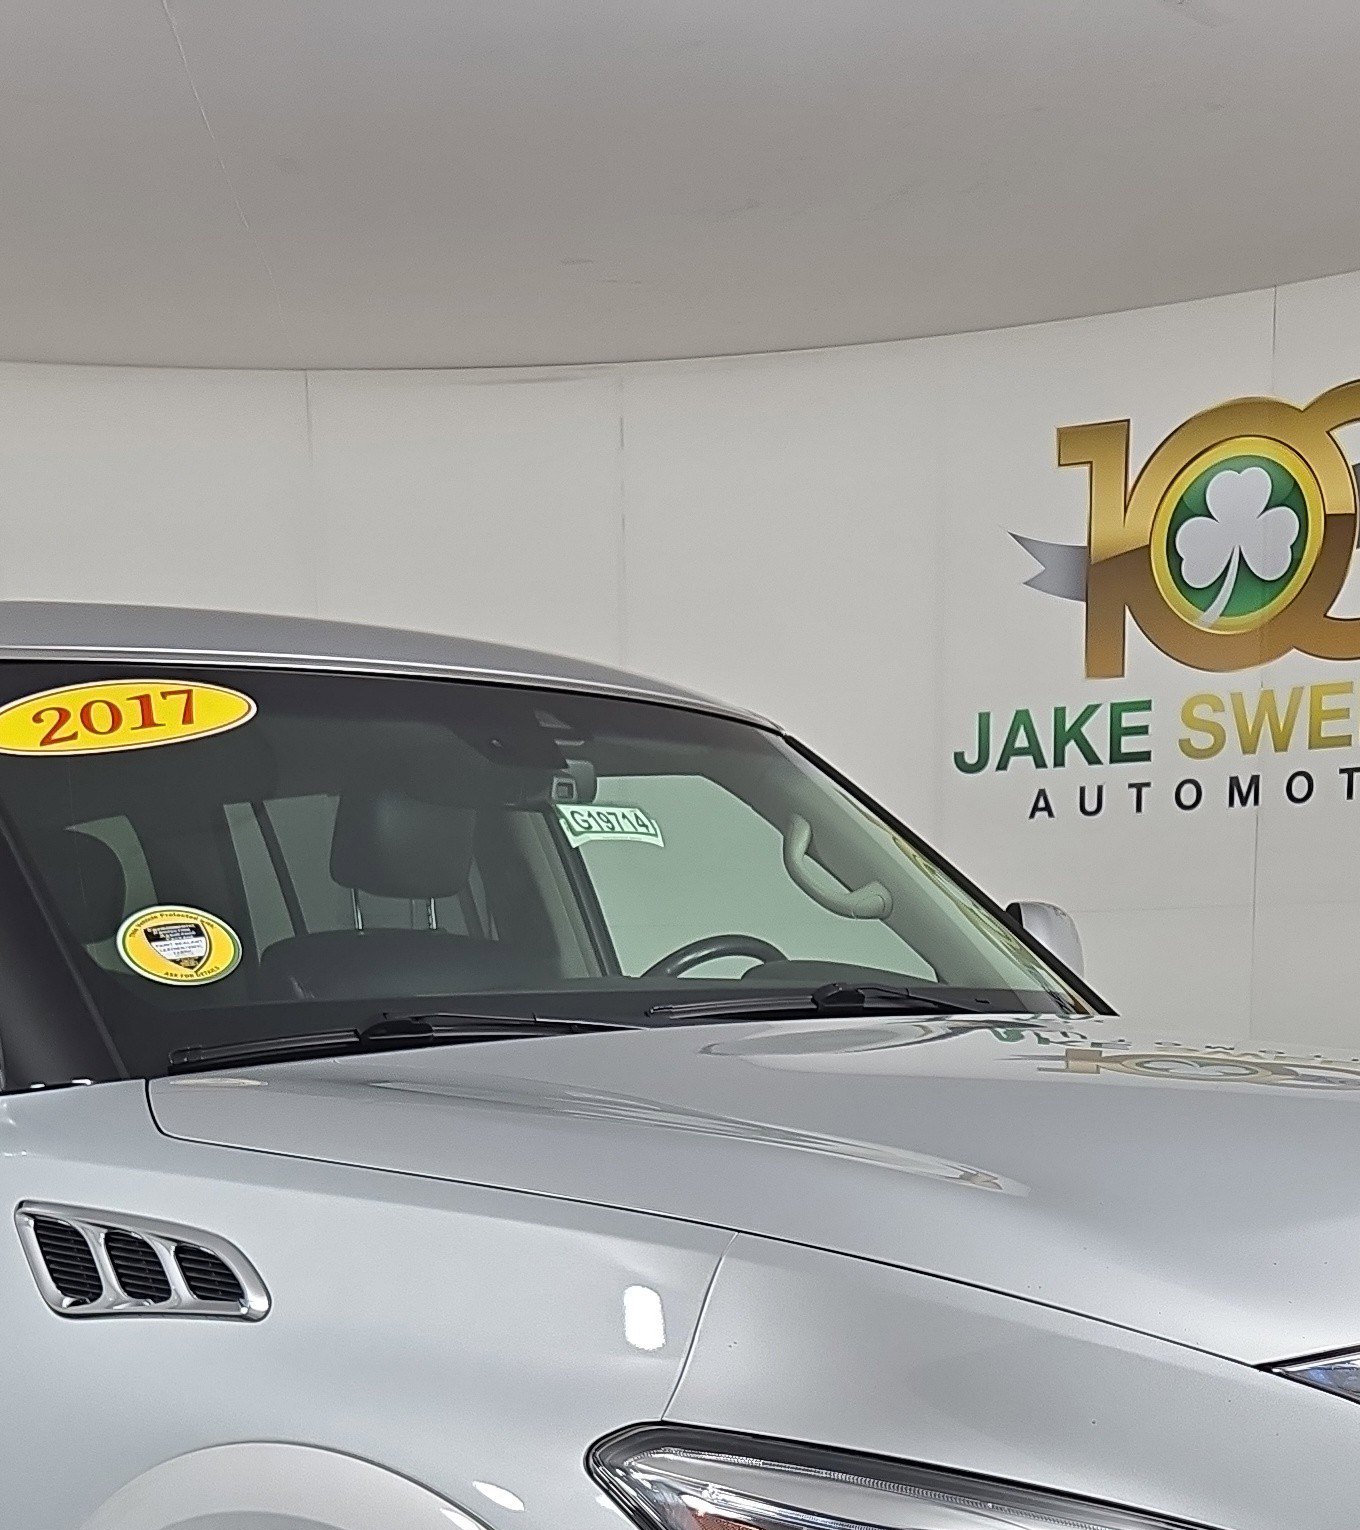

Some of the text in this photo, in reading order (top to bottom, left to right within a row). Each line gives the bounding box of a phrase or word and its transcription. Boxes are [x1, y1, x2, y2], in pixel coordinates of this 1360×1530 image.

[32, 688, 194, 747] 2017
[953, 700, 1153, 775] JAKE
[570, 810, 650, 833] G19714
